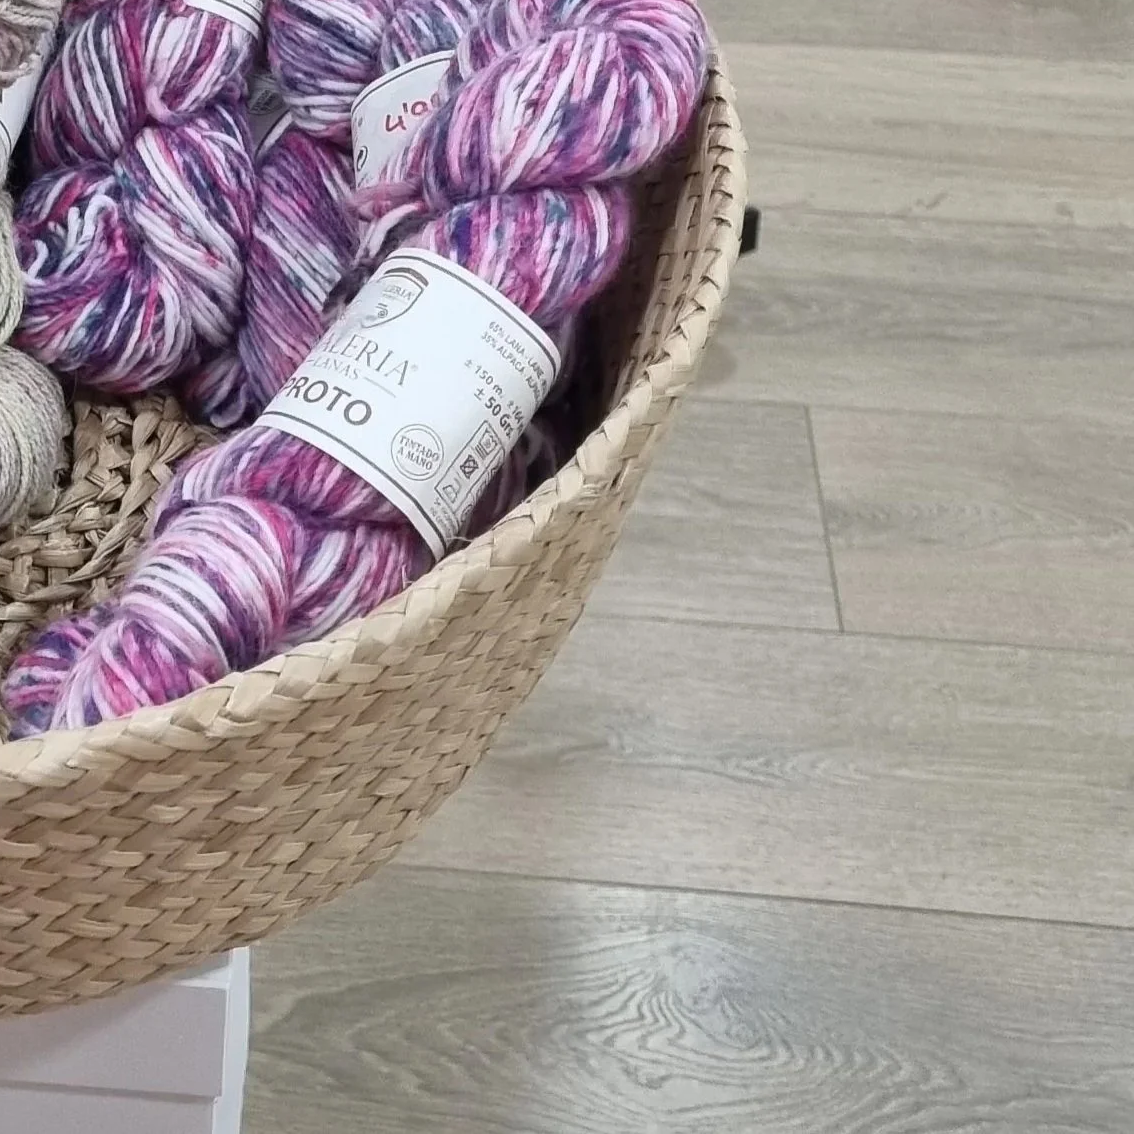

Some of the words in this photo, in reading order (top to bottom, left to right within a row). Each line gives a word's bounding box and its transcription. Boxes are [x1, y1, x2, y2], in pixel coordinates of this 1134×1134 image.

[488, 322, 504, 338] 65%
[505, 335, 525, 355] LANA
[313, 357, 360, 380] LANAS
[321, 332, 409, 386] ALERIA
[497, 346, 525, 374] ALPACA
[474, 365, 494, 385] 150
[282, 376, 372, 426] PROTO
[485, 396, 502, 416] 50
[397, 446, 404, 456] A
[406, 450, 433, 470] MANO
[399, 436, 440, 462] TINTADO
